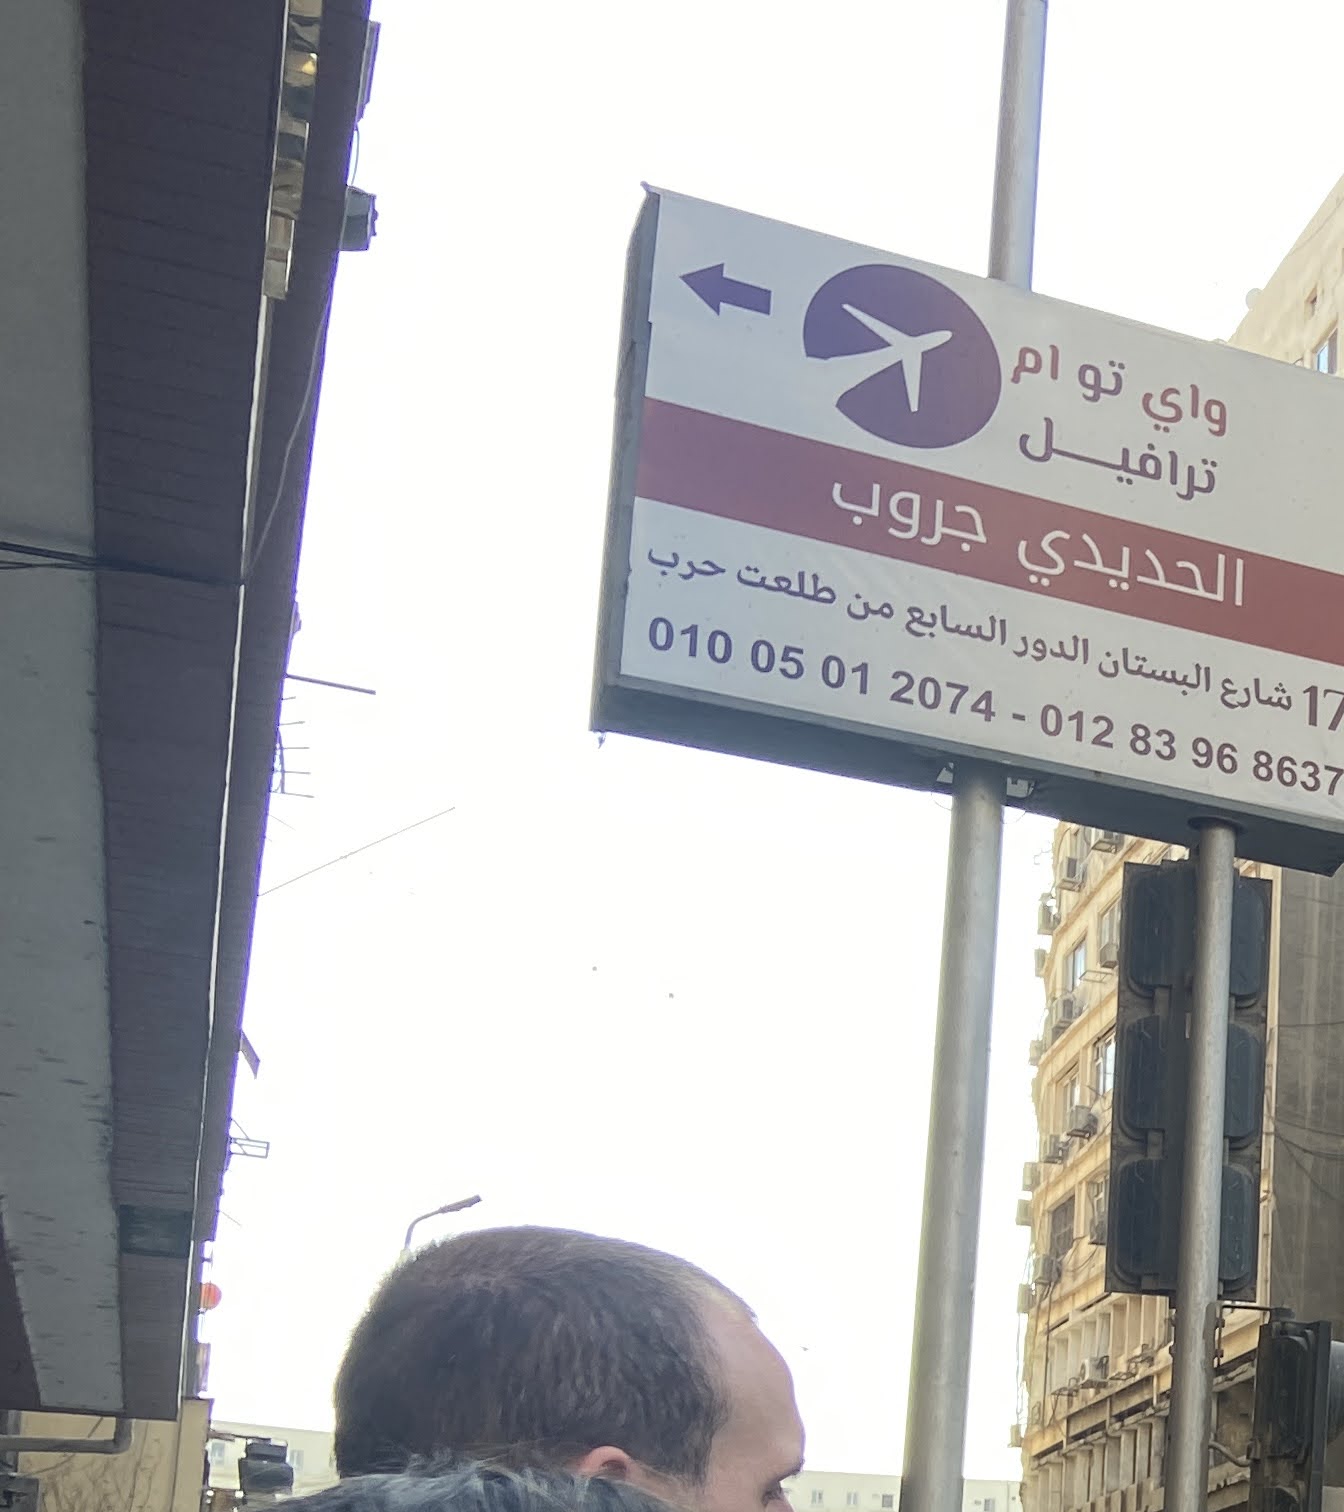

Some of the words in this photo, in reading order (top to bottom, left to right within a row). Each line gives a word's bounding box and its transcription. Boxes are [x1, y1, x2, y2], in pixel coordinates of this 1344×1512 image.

[1010, 344, 1060, 384] ام
[1077, 359, 1126, 402] تو
[1141, 383, 1227, 437] واي
[1018, 416, 1218, 501] ترافيل
[831, 479, 988, 553] جروب
[647, 547, 726, 580] حرب
[736, 564, 837, 605] طلعت
[1017, 530, 1244, 607] الحديدي
[846, 592, 895, 621] من
[905, 604, 1007, 646] السابع
[1012, 633, 1090, 665] الدور
[1098, 647, 1211, 697] البستان
[648, 616, 733, 665] 010
[750, 638, 805, 680] 05
[821, 653, 869, 696] 01
[889, 669, 997, 723] 2074
[1012, 712, 1026, 721] -
[1039, 703, 1115, 749] 012
[1129, 723, 1177, 761] 83
[1191, 737, 1239, 775] 96
[1219, 677, 1293, 712] شارع
